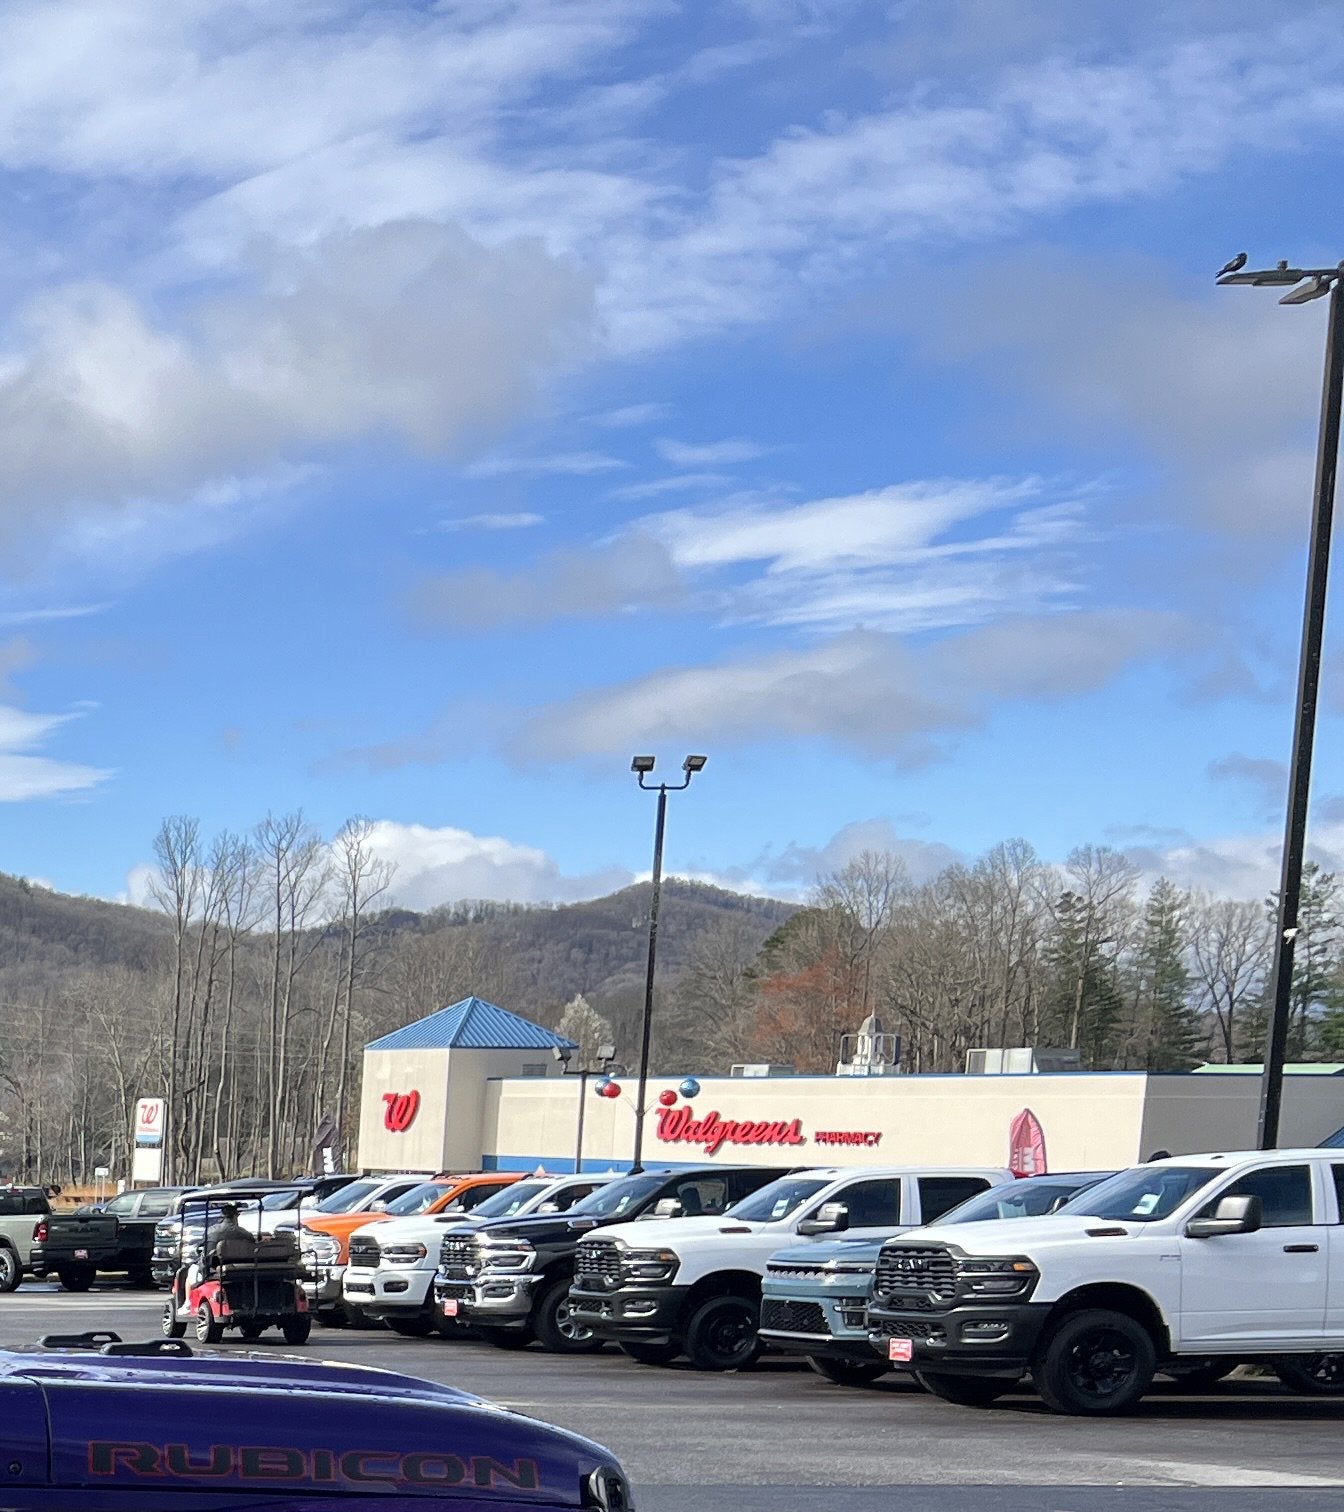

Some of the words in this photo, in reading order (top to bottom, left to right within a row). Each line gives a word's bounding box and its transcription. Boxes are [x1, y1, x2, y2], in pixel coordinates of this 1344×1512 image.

[141, 1103, 159, 1124] W
[382, 1090, 421, 1133] W
[655, 1105, 808, 1157] Walgreens
[814, 1131, 883, 1147] PHARMACY
[87, 1440, 540, 1490] RUBICON
